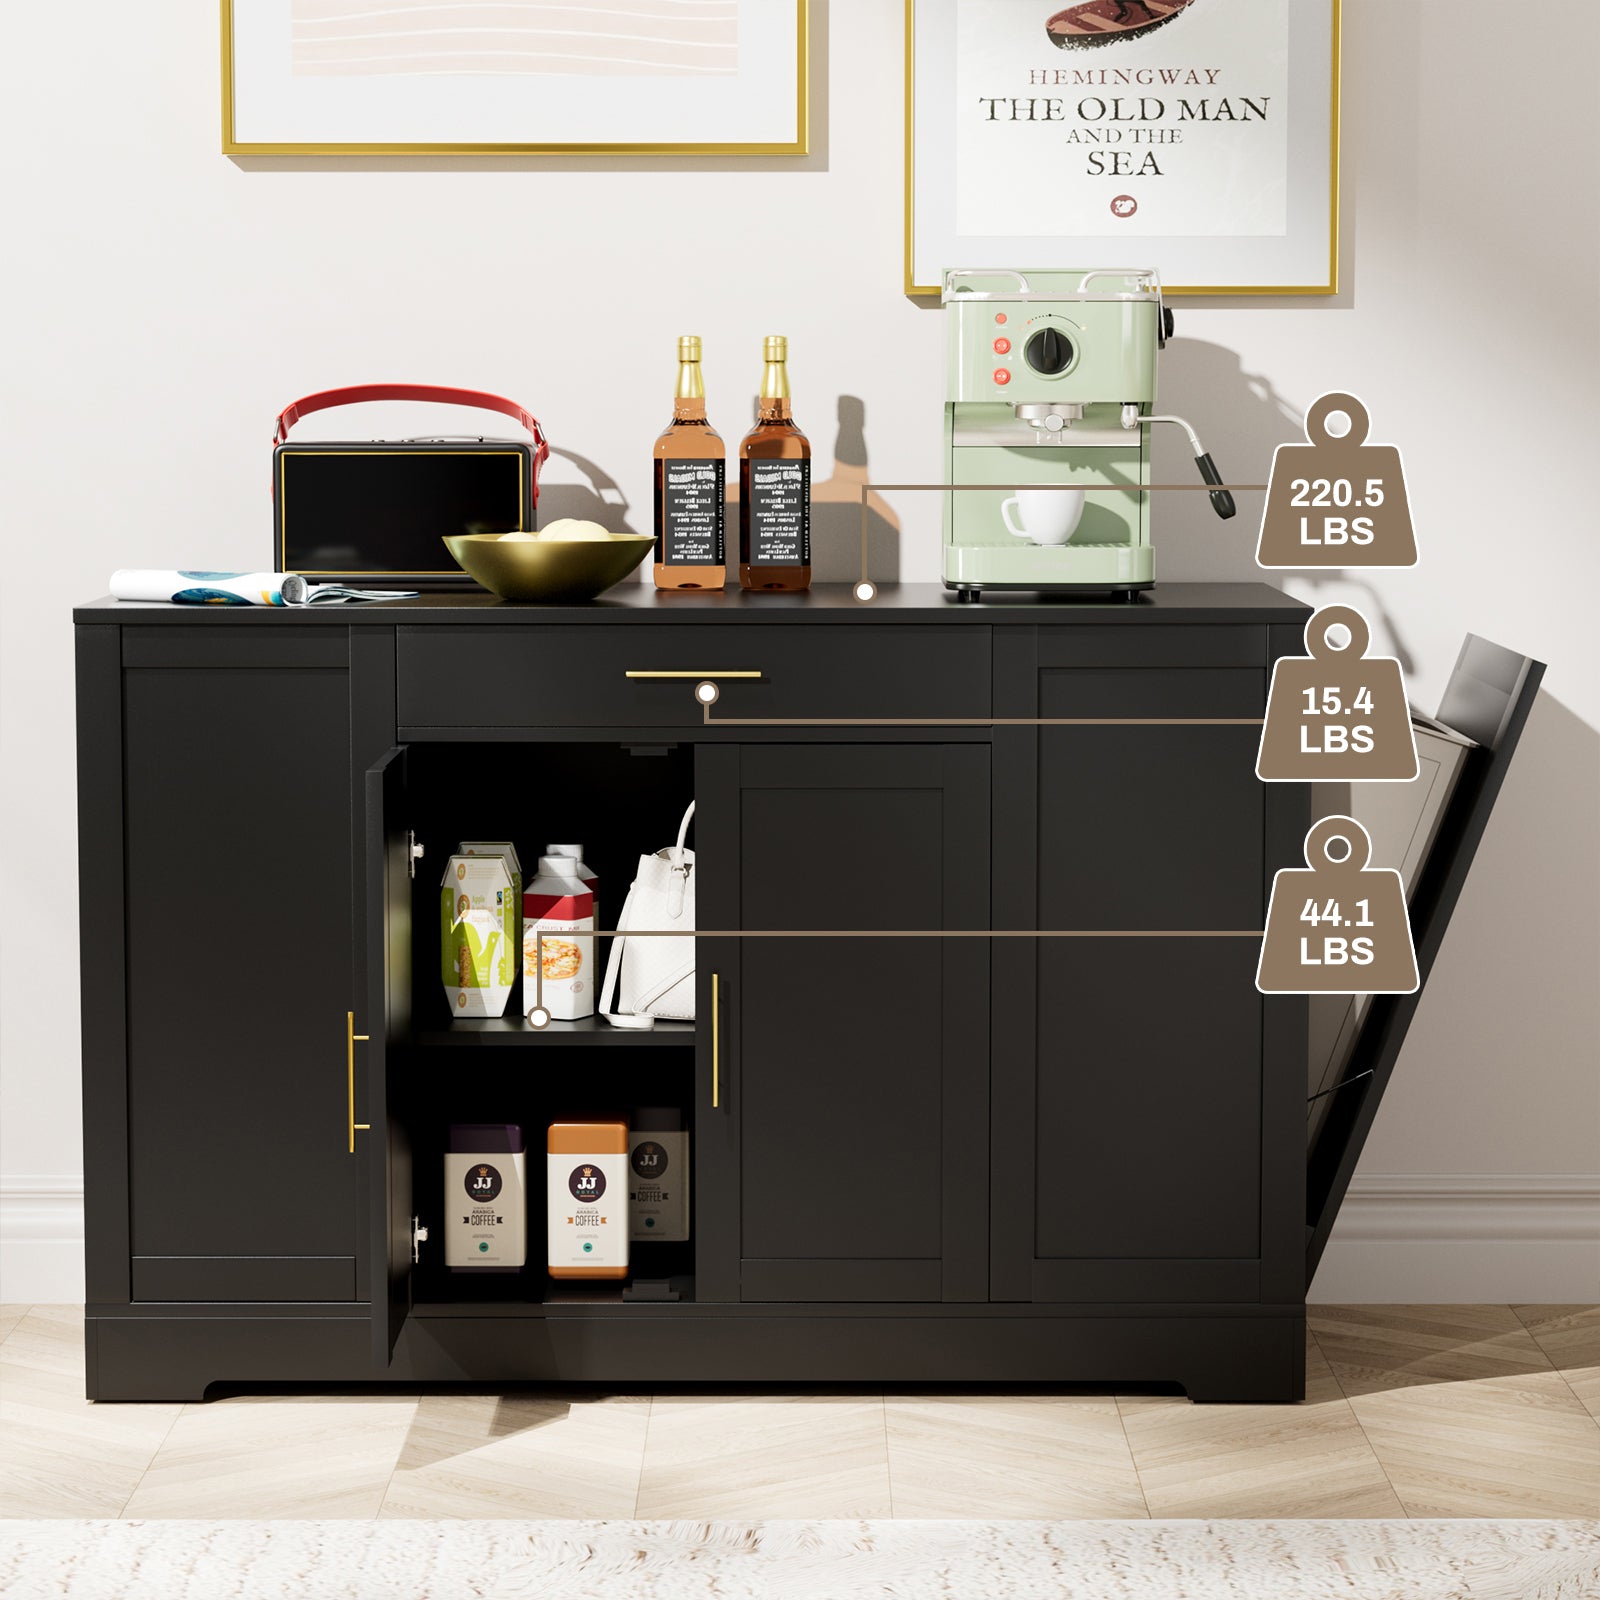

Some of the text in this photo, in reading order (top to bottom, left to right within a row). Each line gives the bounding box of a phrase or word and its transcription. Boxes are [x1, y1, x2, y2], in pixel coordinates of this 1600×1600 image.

[1028, 69, 1222, 85] HEMINGWAY
[979, 97, 1271, 121] THE OLD MAN
[1066, 128, 1183, 144] AND THE
[1086, 151, 1164, 176] SEA
[640, 1154, 659, 1166] JJ
[473, 1176, 493, 1189] JJ
[577, 1177, 597, 1190] JJ
[637, 1191, 662, 1202] COFFEE
[471, 1215, 496, 1226] COFFEE
[575, 1215, 600, 1226] COFFEE
